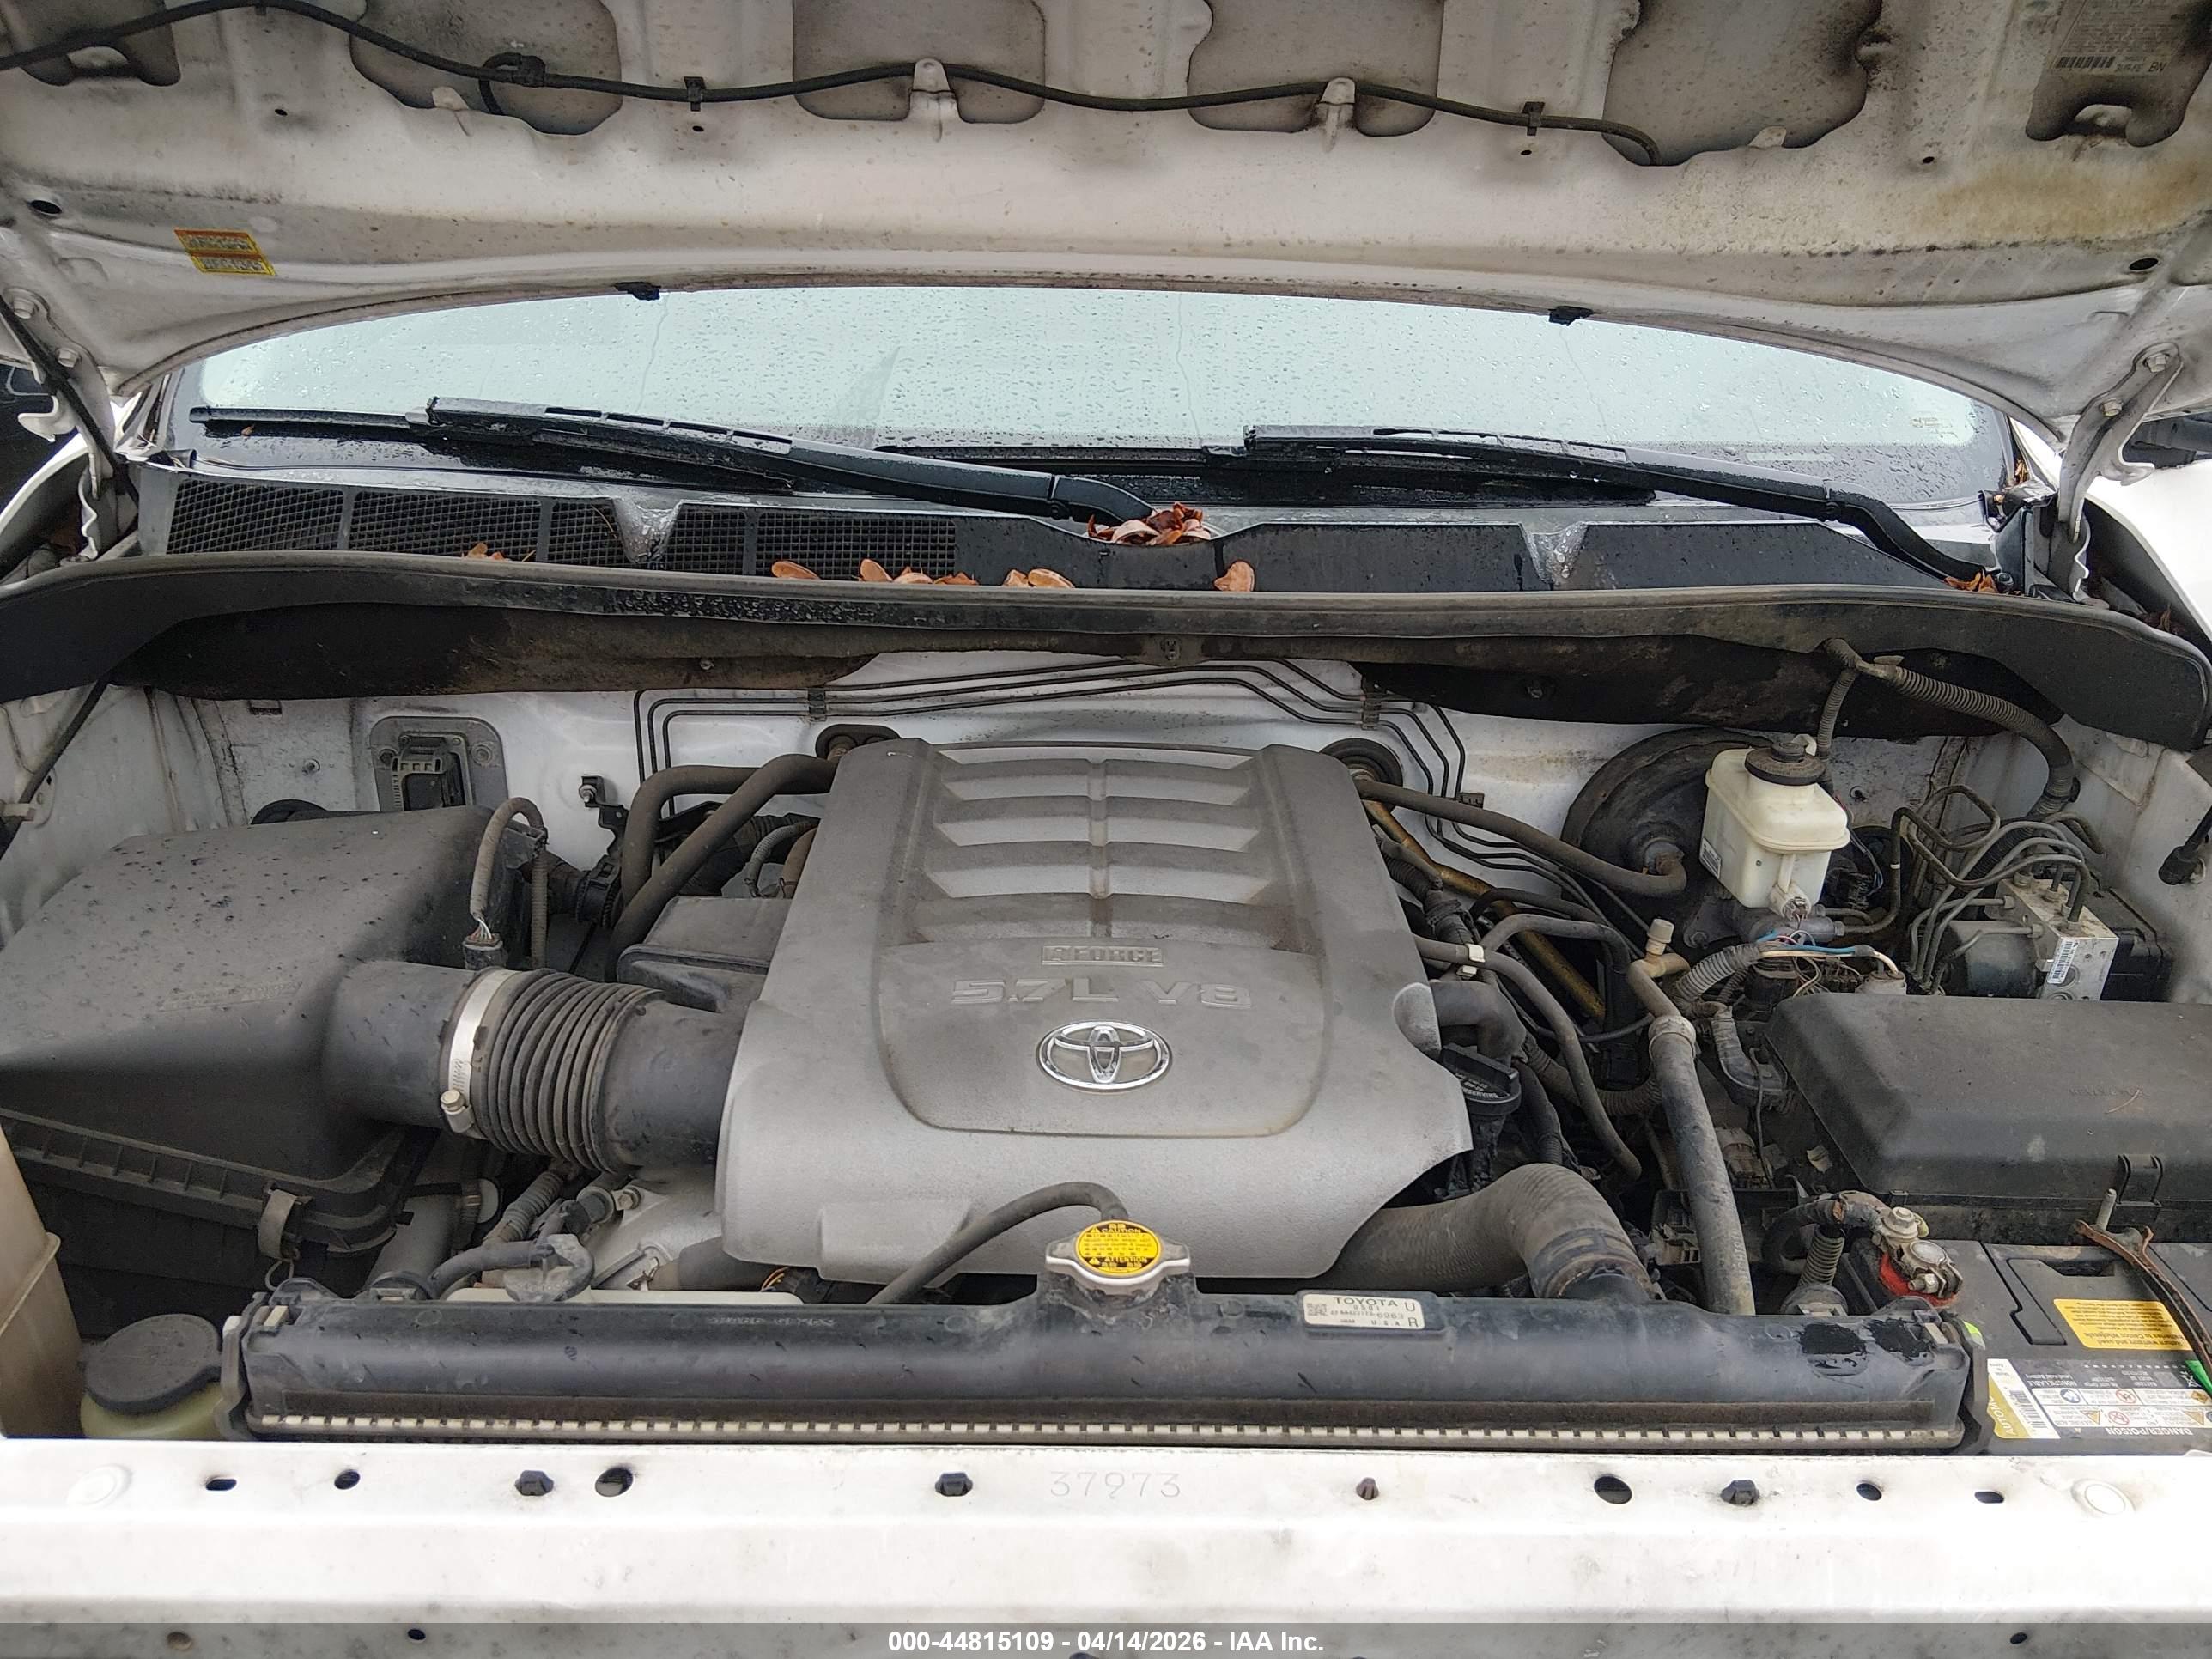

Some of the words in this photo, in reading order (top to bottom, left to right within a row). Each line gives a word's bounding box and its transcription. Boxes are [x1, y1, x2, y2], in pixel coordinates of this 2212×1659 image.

[951, 977, 1119, 1004] 5.7L
[1139, 980, 1251, 1009] V8
[1334, 1297, 1399, 1307] TOYOTA
[1404, 1302, 1416, 1312] U
[1407, 1316, 1419, 1328] R
